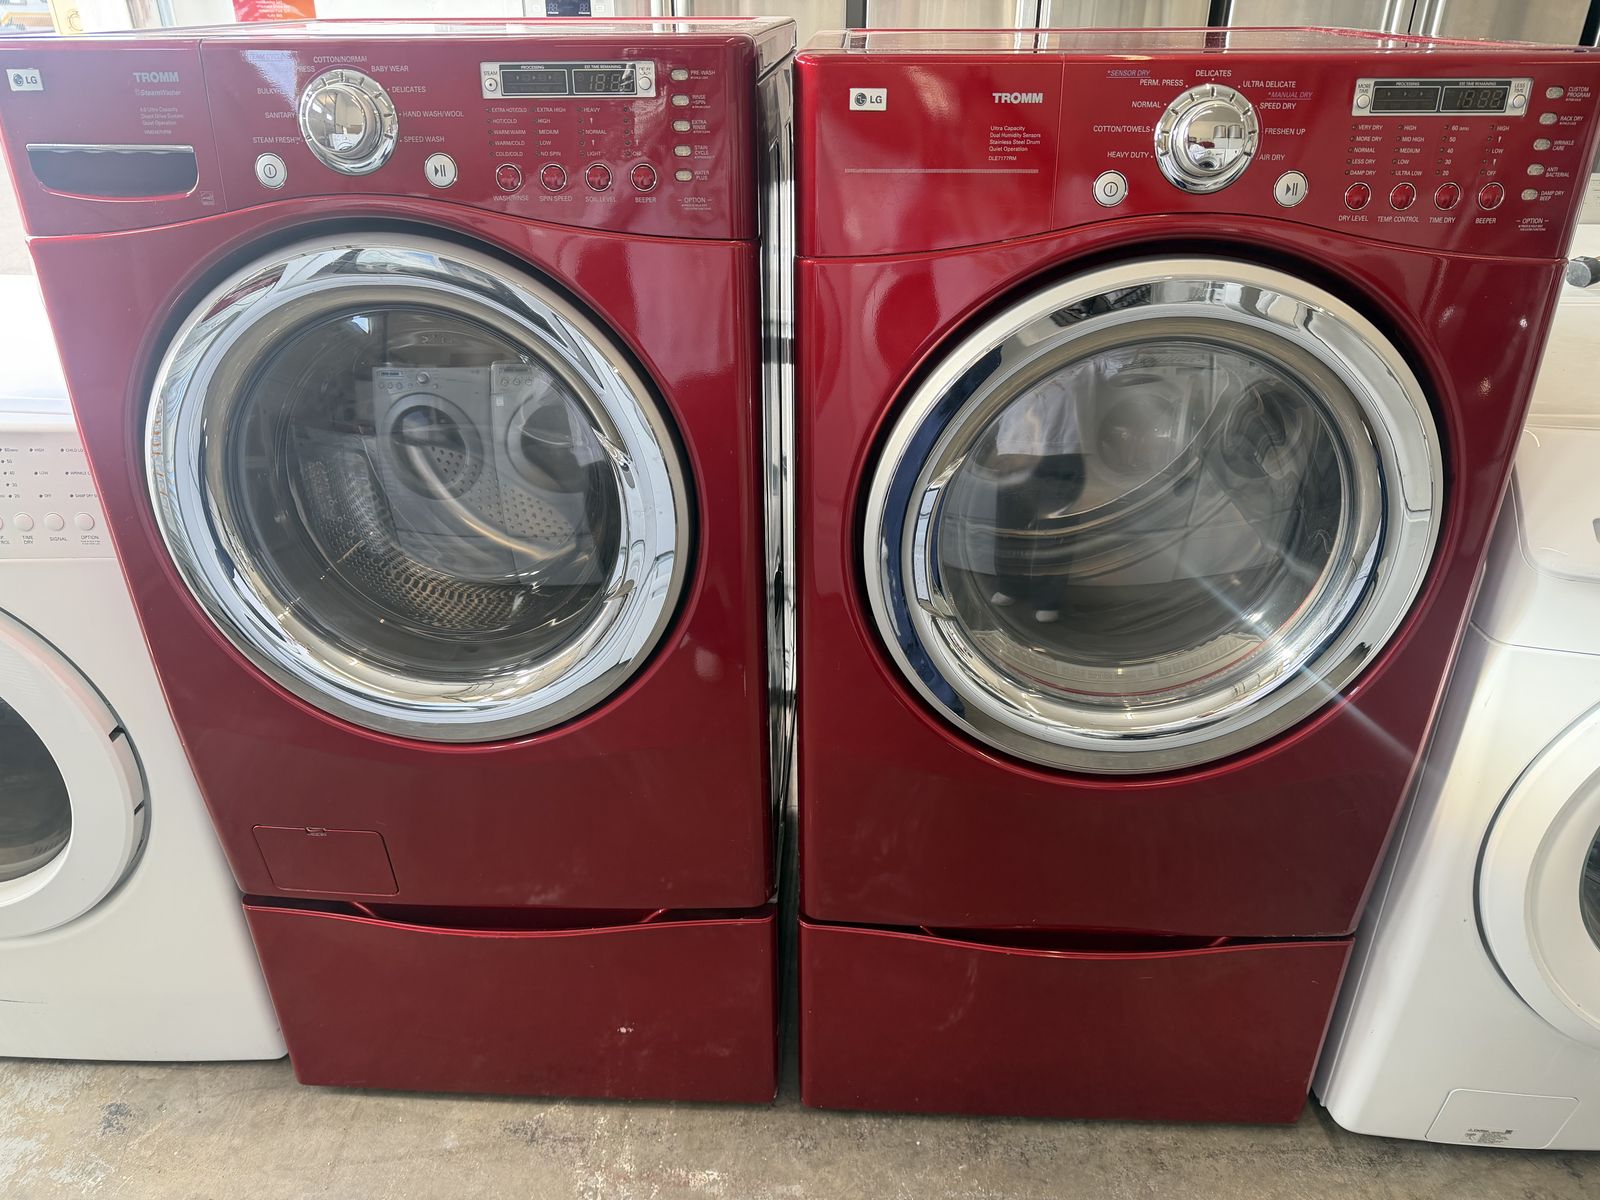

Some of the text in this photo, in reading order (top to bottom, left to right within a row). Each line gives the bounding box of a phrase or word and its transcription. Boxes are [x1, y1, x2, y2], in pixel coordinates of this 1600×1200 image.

[25, 75, 38, 84] LG
[132, 72, 180, 83] TROMM
[870, 96, 882, 104] LG
[992, 92, 1044, 104] TROMM
